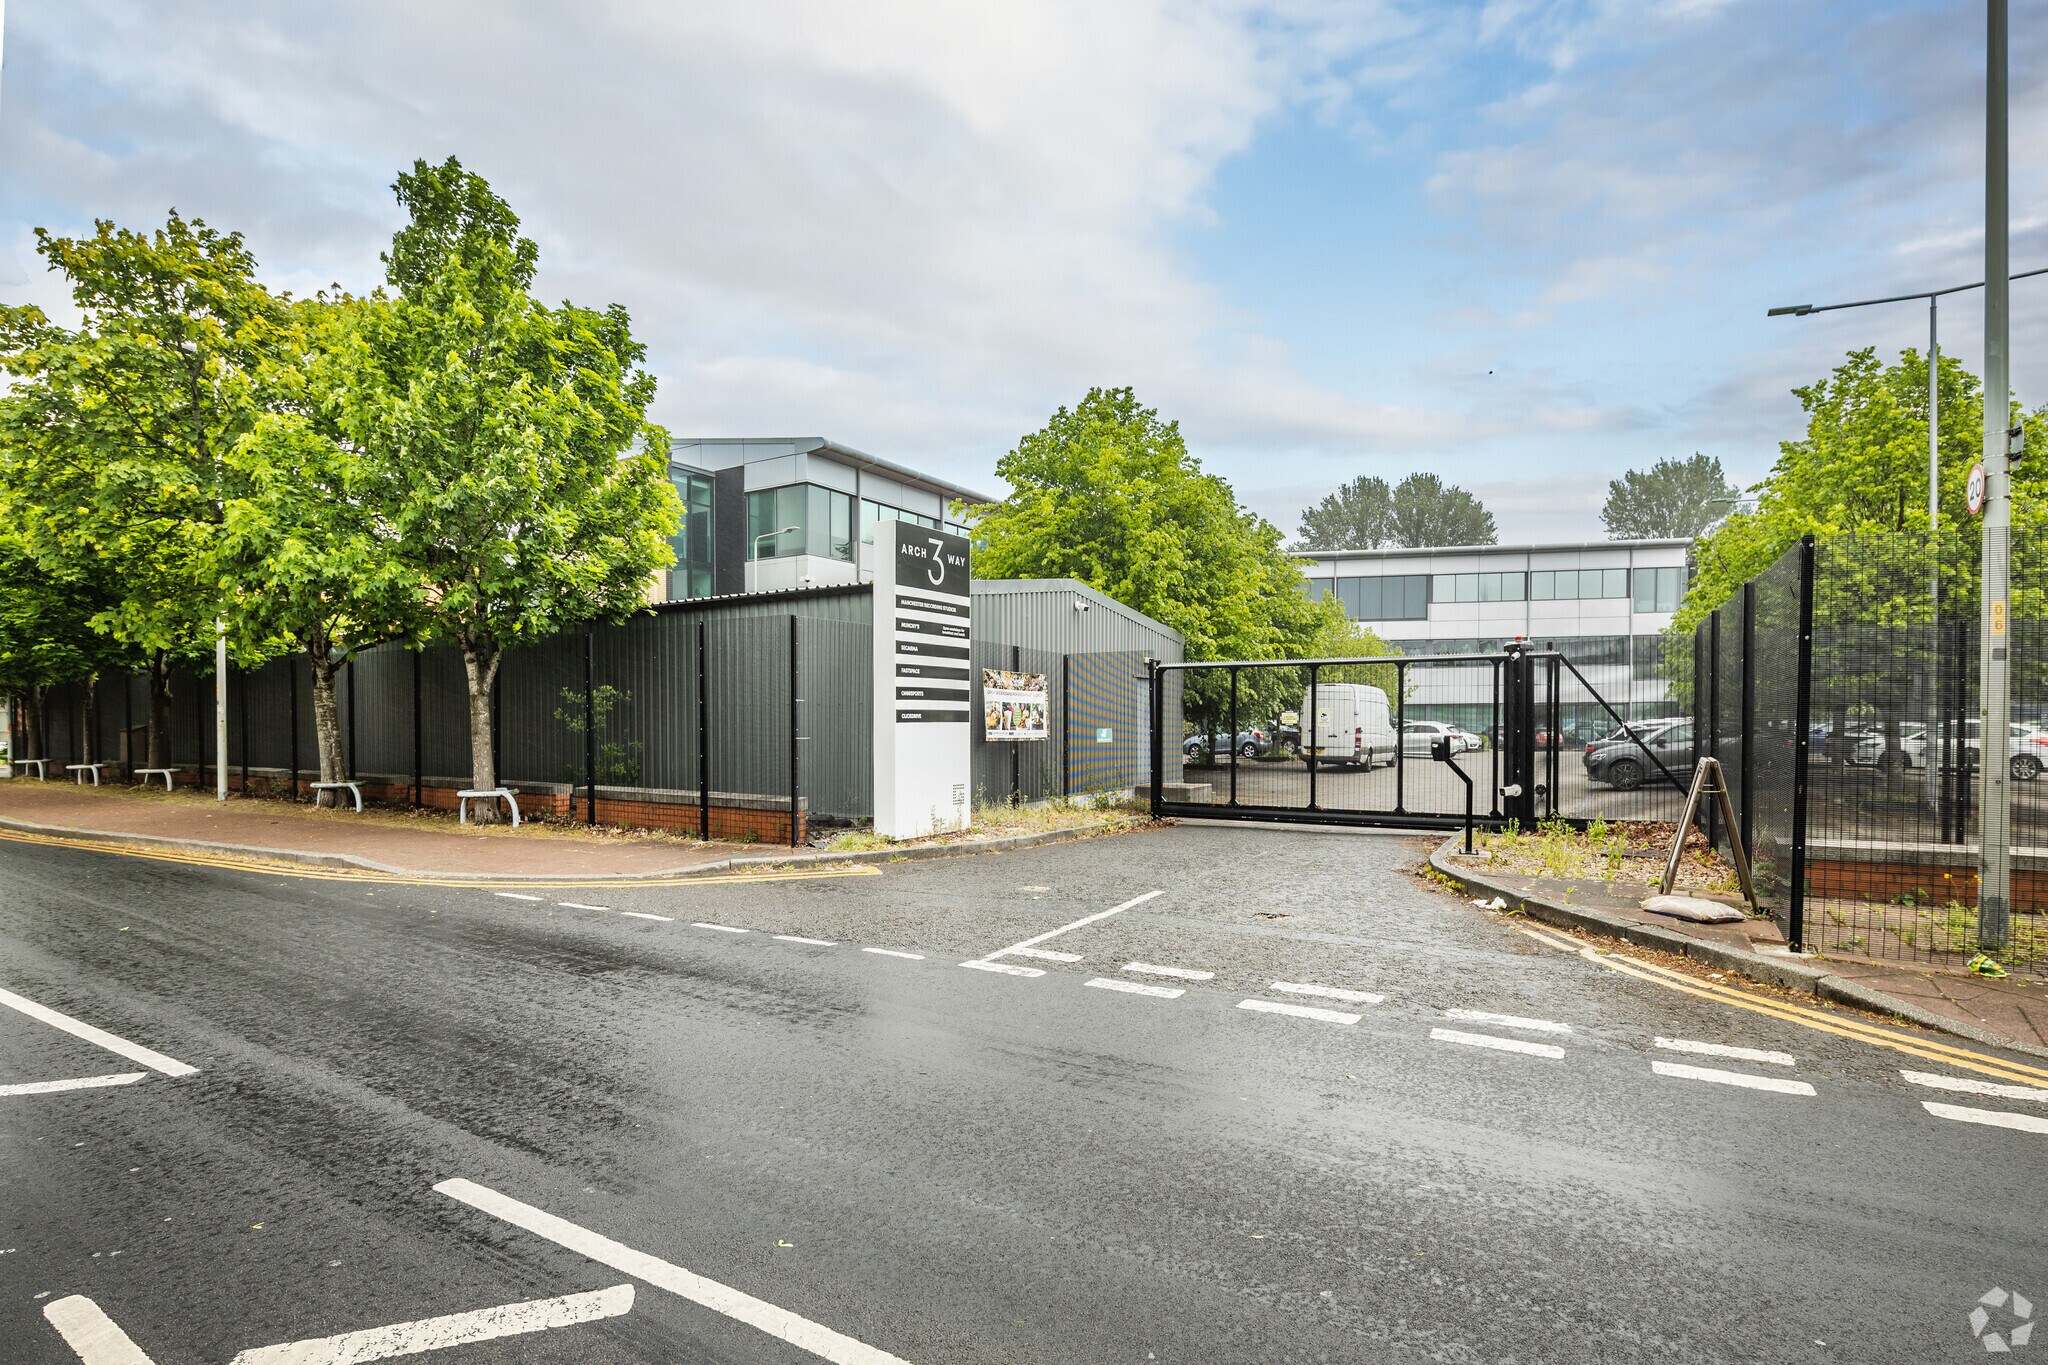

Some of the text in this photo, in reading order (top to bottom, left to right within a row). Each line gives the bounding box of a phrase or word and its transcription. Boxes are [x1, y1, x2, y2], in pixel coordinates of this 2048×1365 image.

[1970, 477, 1981, 501] 20
[901, 537, 966, 586] ARCH 3 WAY
[924, 602, 943, 610] RECORDING
